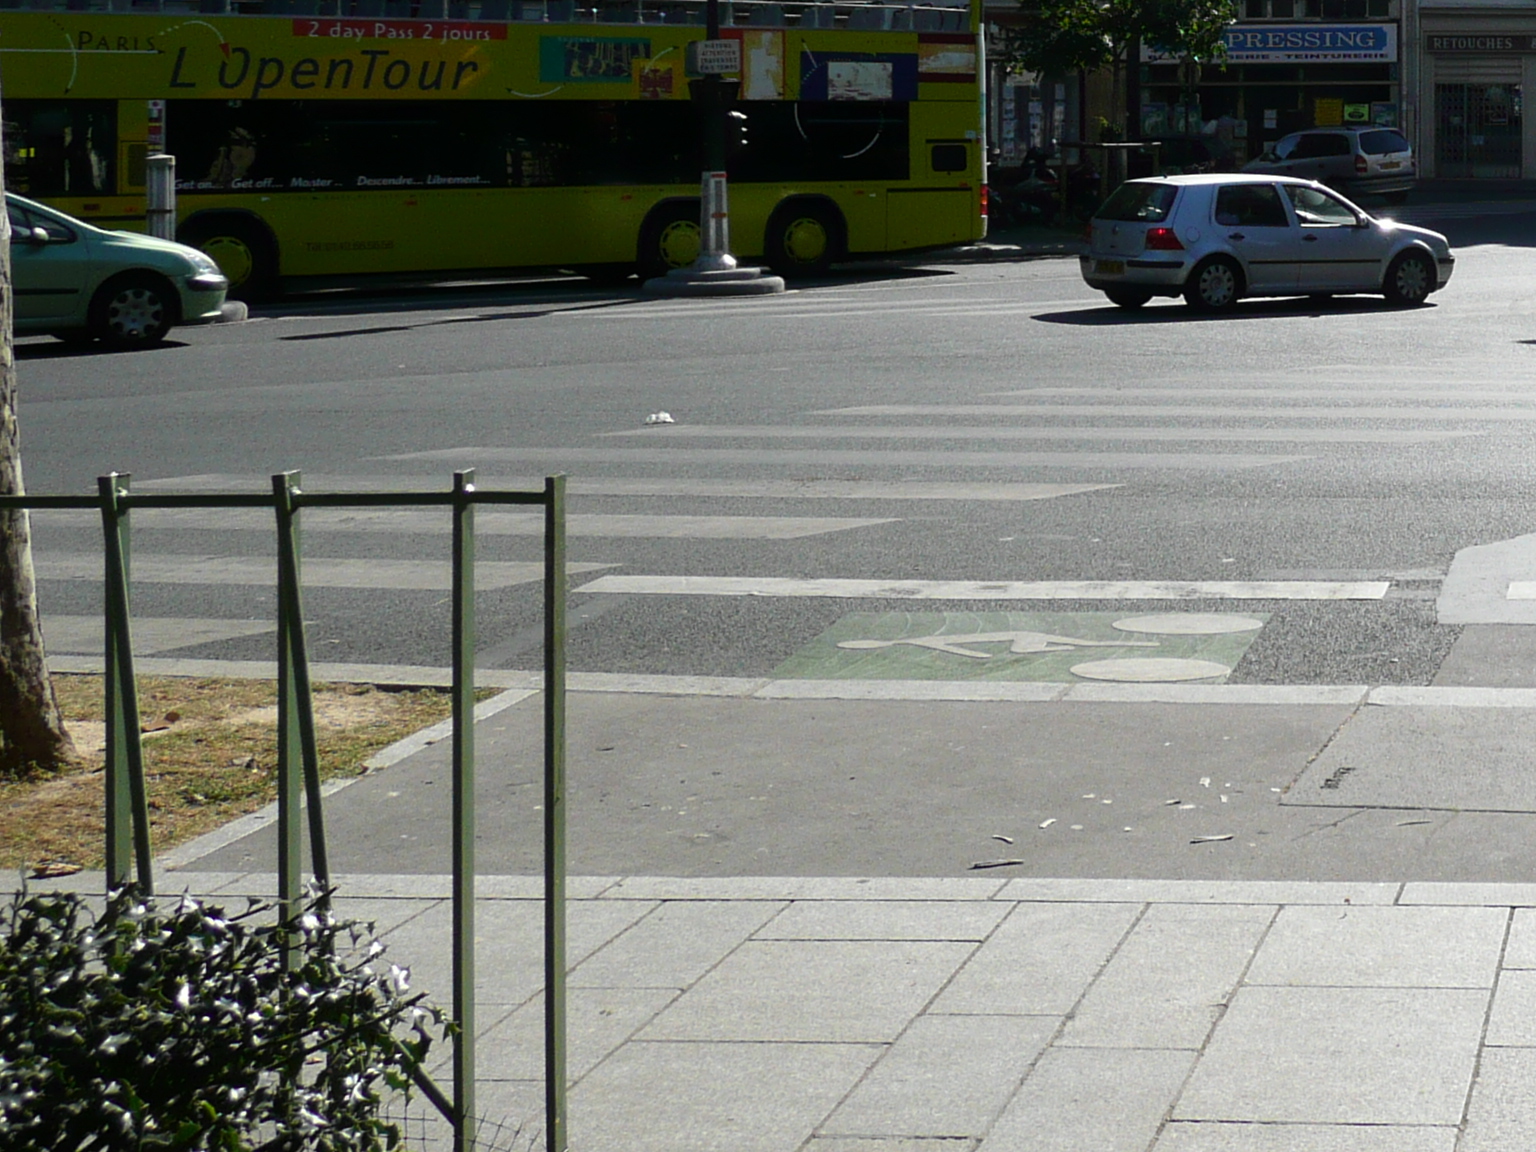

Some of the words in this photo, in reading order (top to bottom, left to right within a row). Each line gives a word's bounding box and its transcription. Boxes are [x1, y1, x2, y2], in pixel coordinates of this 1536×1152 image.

[308, 20, 320, 38] 2
[329, 22, 366, 43] day
[374, 23, 414, 40] Pass
[422, 23, 433, 39] 2
[441, 25, 491, 46] jours
[1225, 30, 1376, 49] PRESSING
[1432, 36, 1514, 51] RETOUCHES
